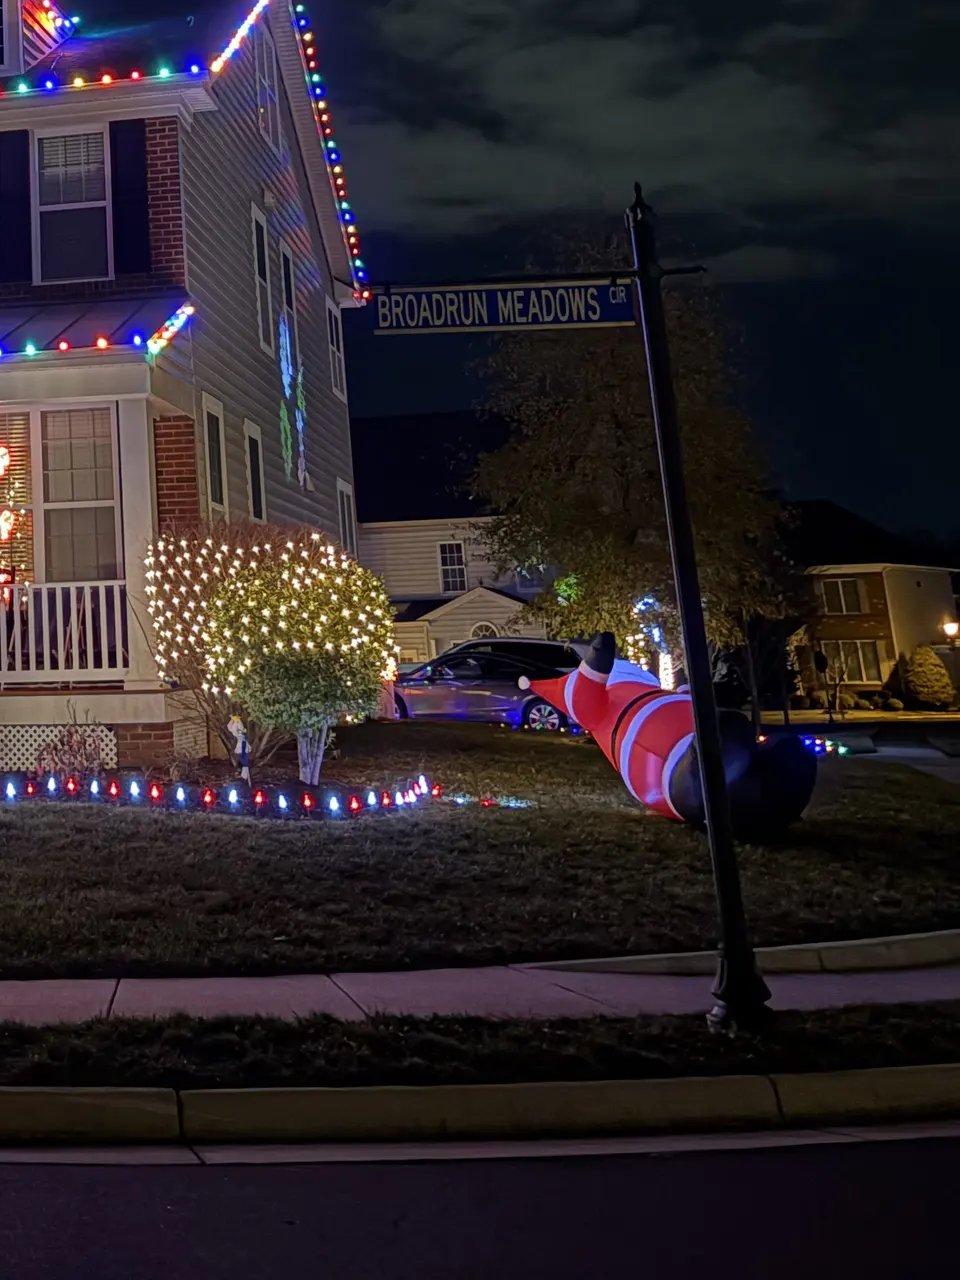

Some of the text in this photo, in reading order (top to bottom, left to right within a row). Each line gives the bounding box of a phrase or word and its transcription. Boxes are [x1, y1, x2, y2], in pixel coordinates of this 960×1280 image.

[378, 286, 627, 327] BROADRUN MEADOWS CIR
